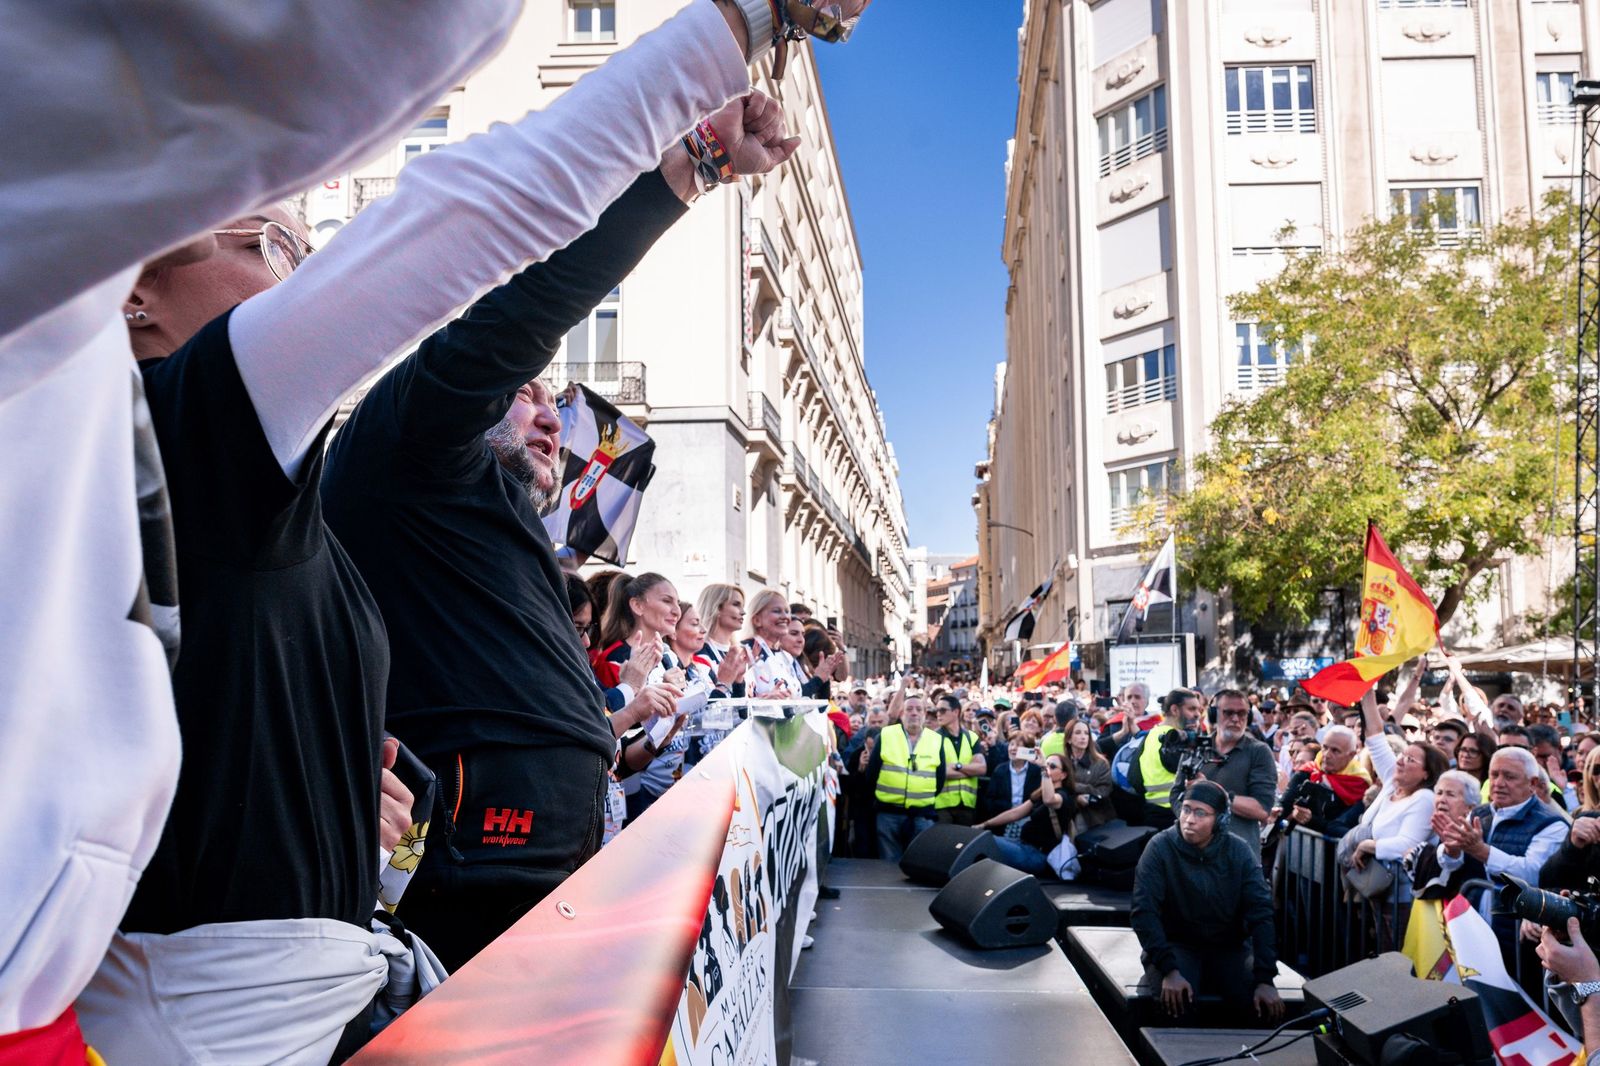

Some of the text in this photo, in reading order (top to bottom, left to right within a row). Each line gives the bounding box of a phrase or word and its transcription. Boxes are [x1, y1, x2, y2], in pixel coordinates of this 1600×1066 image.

[1279, 657, 1318, 669] GINZA
[483, 808, 534, 833] HH
[720, 948, 755, 1021] MUERES
